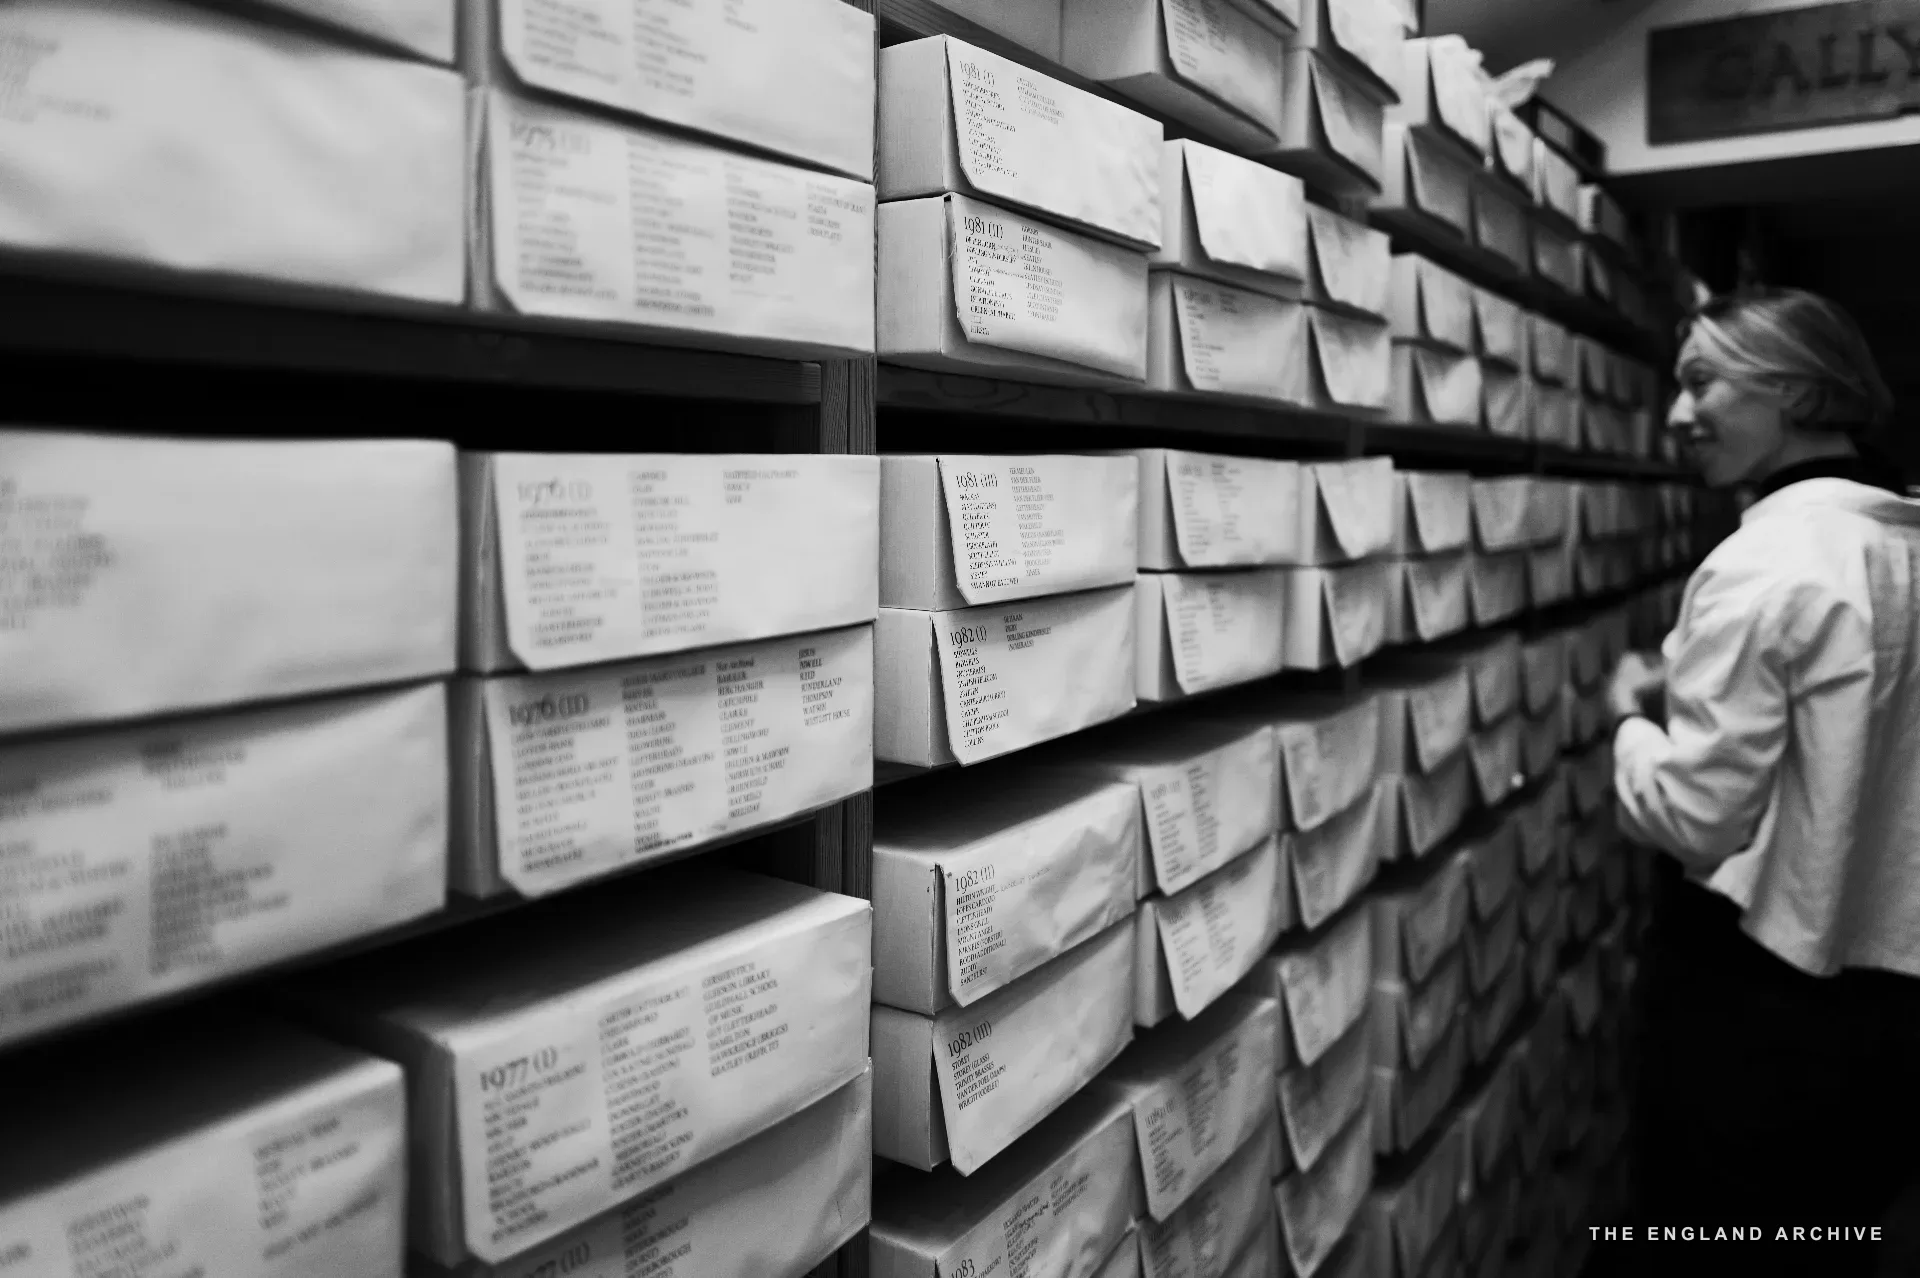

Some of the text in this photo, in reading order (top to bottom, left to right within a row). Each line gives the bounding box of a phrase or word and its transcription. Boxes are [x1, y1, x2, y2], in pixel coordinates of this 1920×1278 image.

[959, 60, 980, 80] 1981
[964, 216, 985, 236] 1981
[988, 221, 1003, 240] (II)
[955, 471, 979, 491] 1981
[950, 626, 974, 649] 1982
[975, 625, 987, 643] (I)
[801, 677, 842, 692] SUNDERLAND
[803, 690, 833, 704] THOMPSON
[803, 702, 827, 715] WATSON
[832, 708, 851, 720] HOUSE
[956, 870, 978, 895] 1982
[980, 863, 995, 883] (II)
[974, 938, 1007, 961] (ADDITIONAL)
[739, 968, 770, 988] LIBRARY
[749, 979, 778, 995] SCHOOL
[720, 1003, 744, 1020] MUSIC
[722, 1003, 778, 1032] (LETTERHEAD)
[948, 1020, 992, 1058] 1982 (III)
[480, 1044, 558, 1091] 1977 (I)
[951, 1054, 970, 1071] STOREY
[954, 1053, 990, 1081] STOREY (GLASS)
[955, 1061, 994, 1090] TRINITY BRASSES
[956, 1089, 968, 1100] VAN
[967, 1083, 979, 1094] DER
[978, 1074, 990, 1088] POEL
[958, 1092, 978, 1111] WRIGHT
